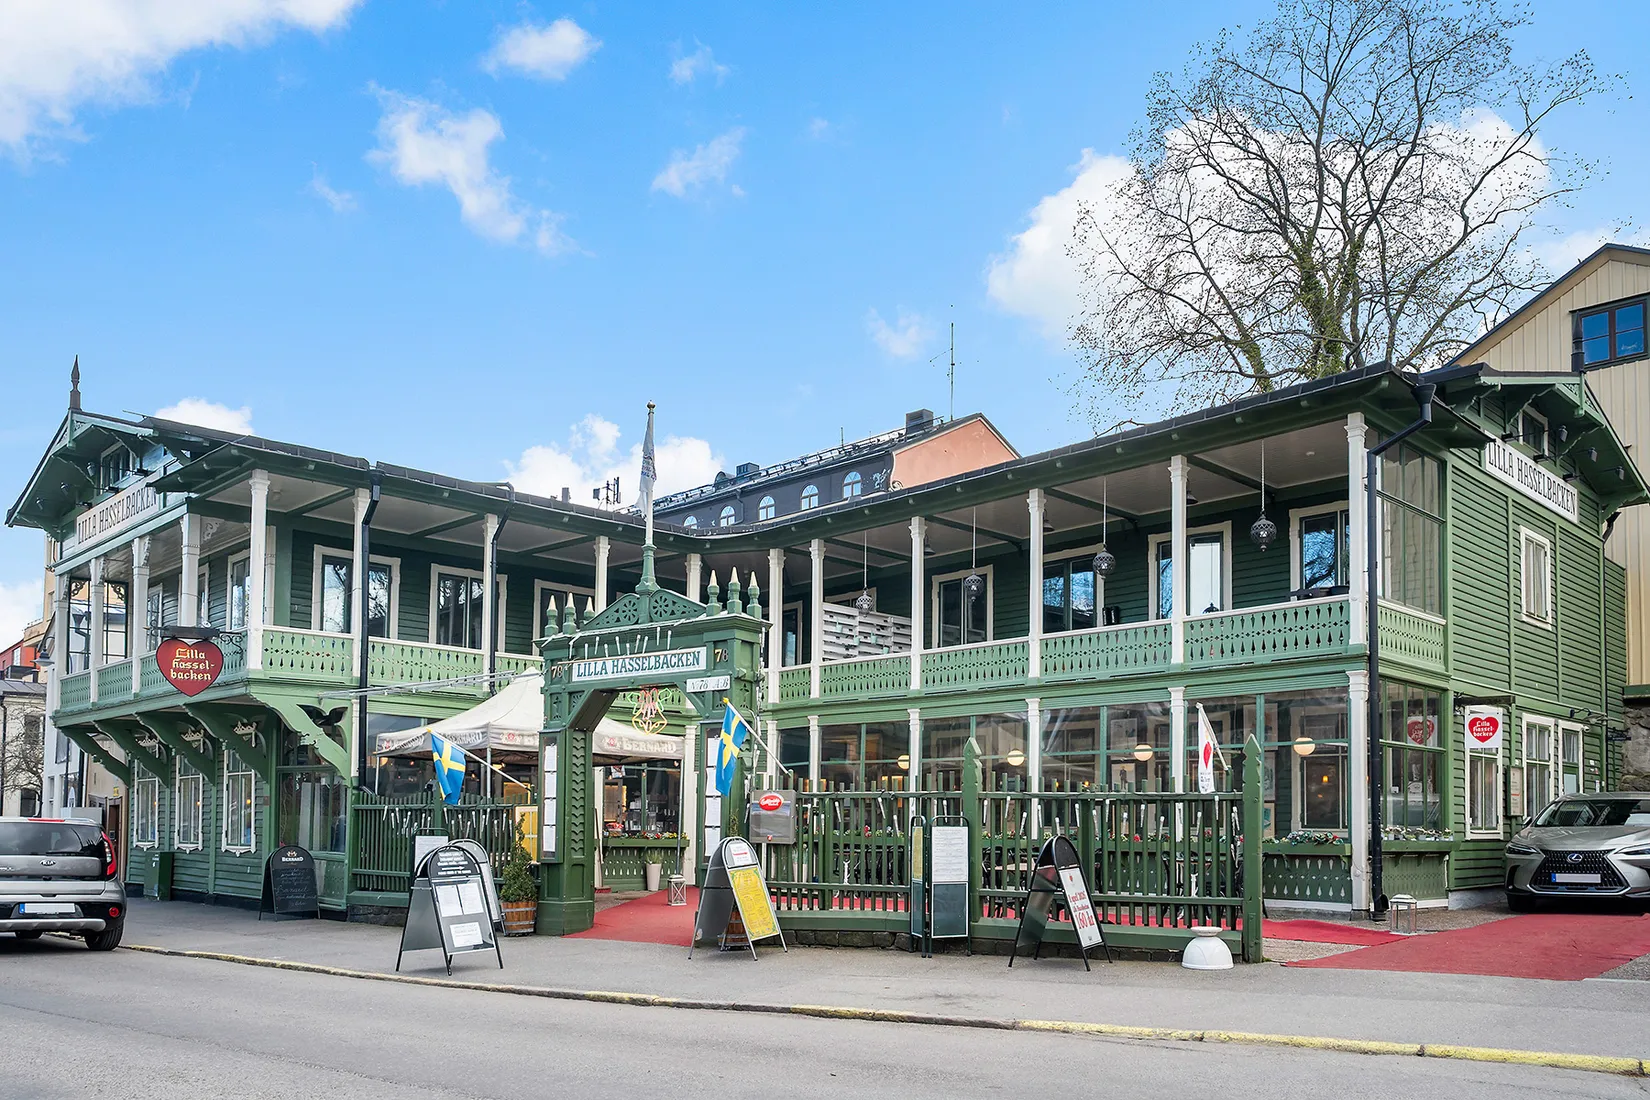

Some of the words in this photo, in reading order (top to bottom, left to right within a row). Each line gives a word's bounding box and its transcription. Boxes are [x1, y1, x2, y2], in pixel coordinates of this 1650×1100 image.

[1488, 442, 1514, 478] LILLA
[1517, 457, 1576, 516] HASSELBACKEN
[78, 514, 97, 545] LILLA
[99, 486, 157, 534] HASSELBACKEN
[175, 648, 206, 659] Lilla
[714, 648, 729, 663] 78
[576, 660, 609, 678] LILLA
[611, 650, 701, 675] HASSELBACKEN
[170, 669, 212, 681] backen
[550, 665, 563, 680] 78
[623, 737, 677, 754] BERNARD
